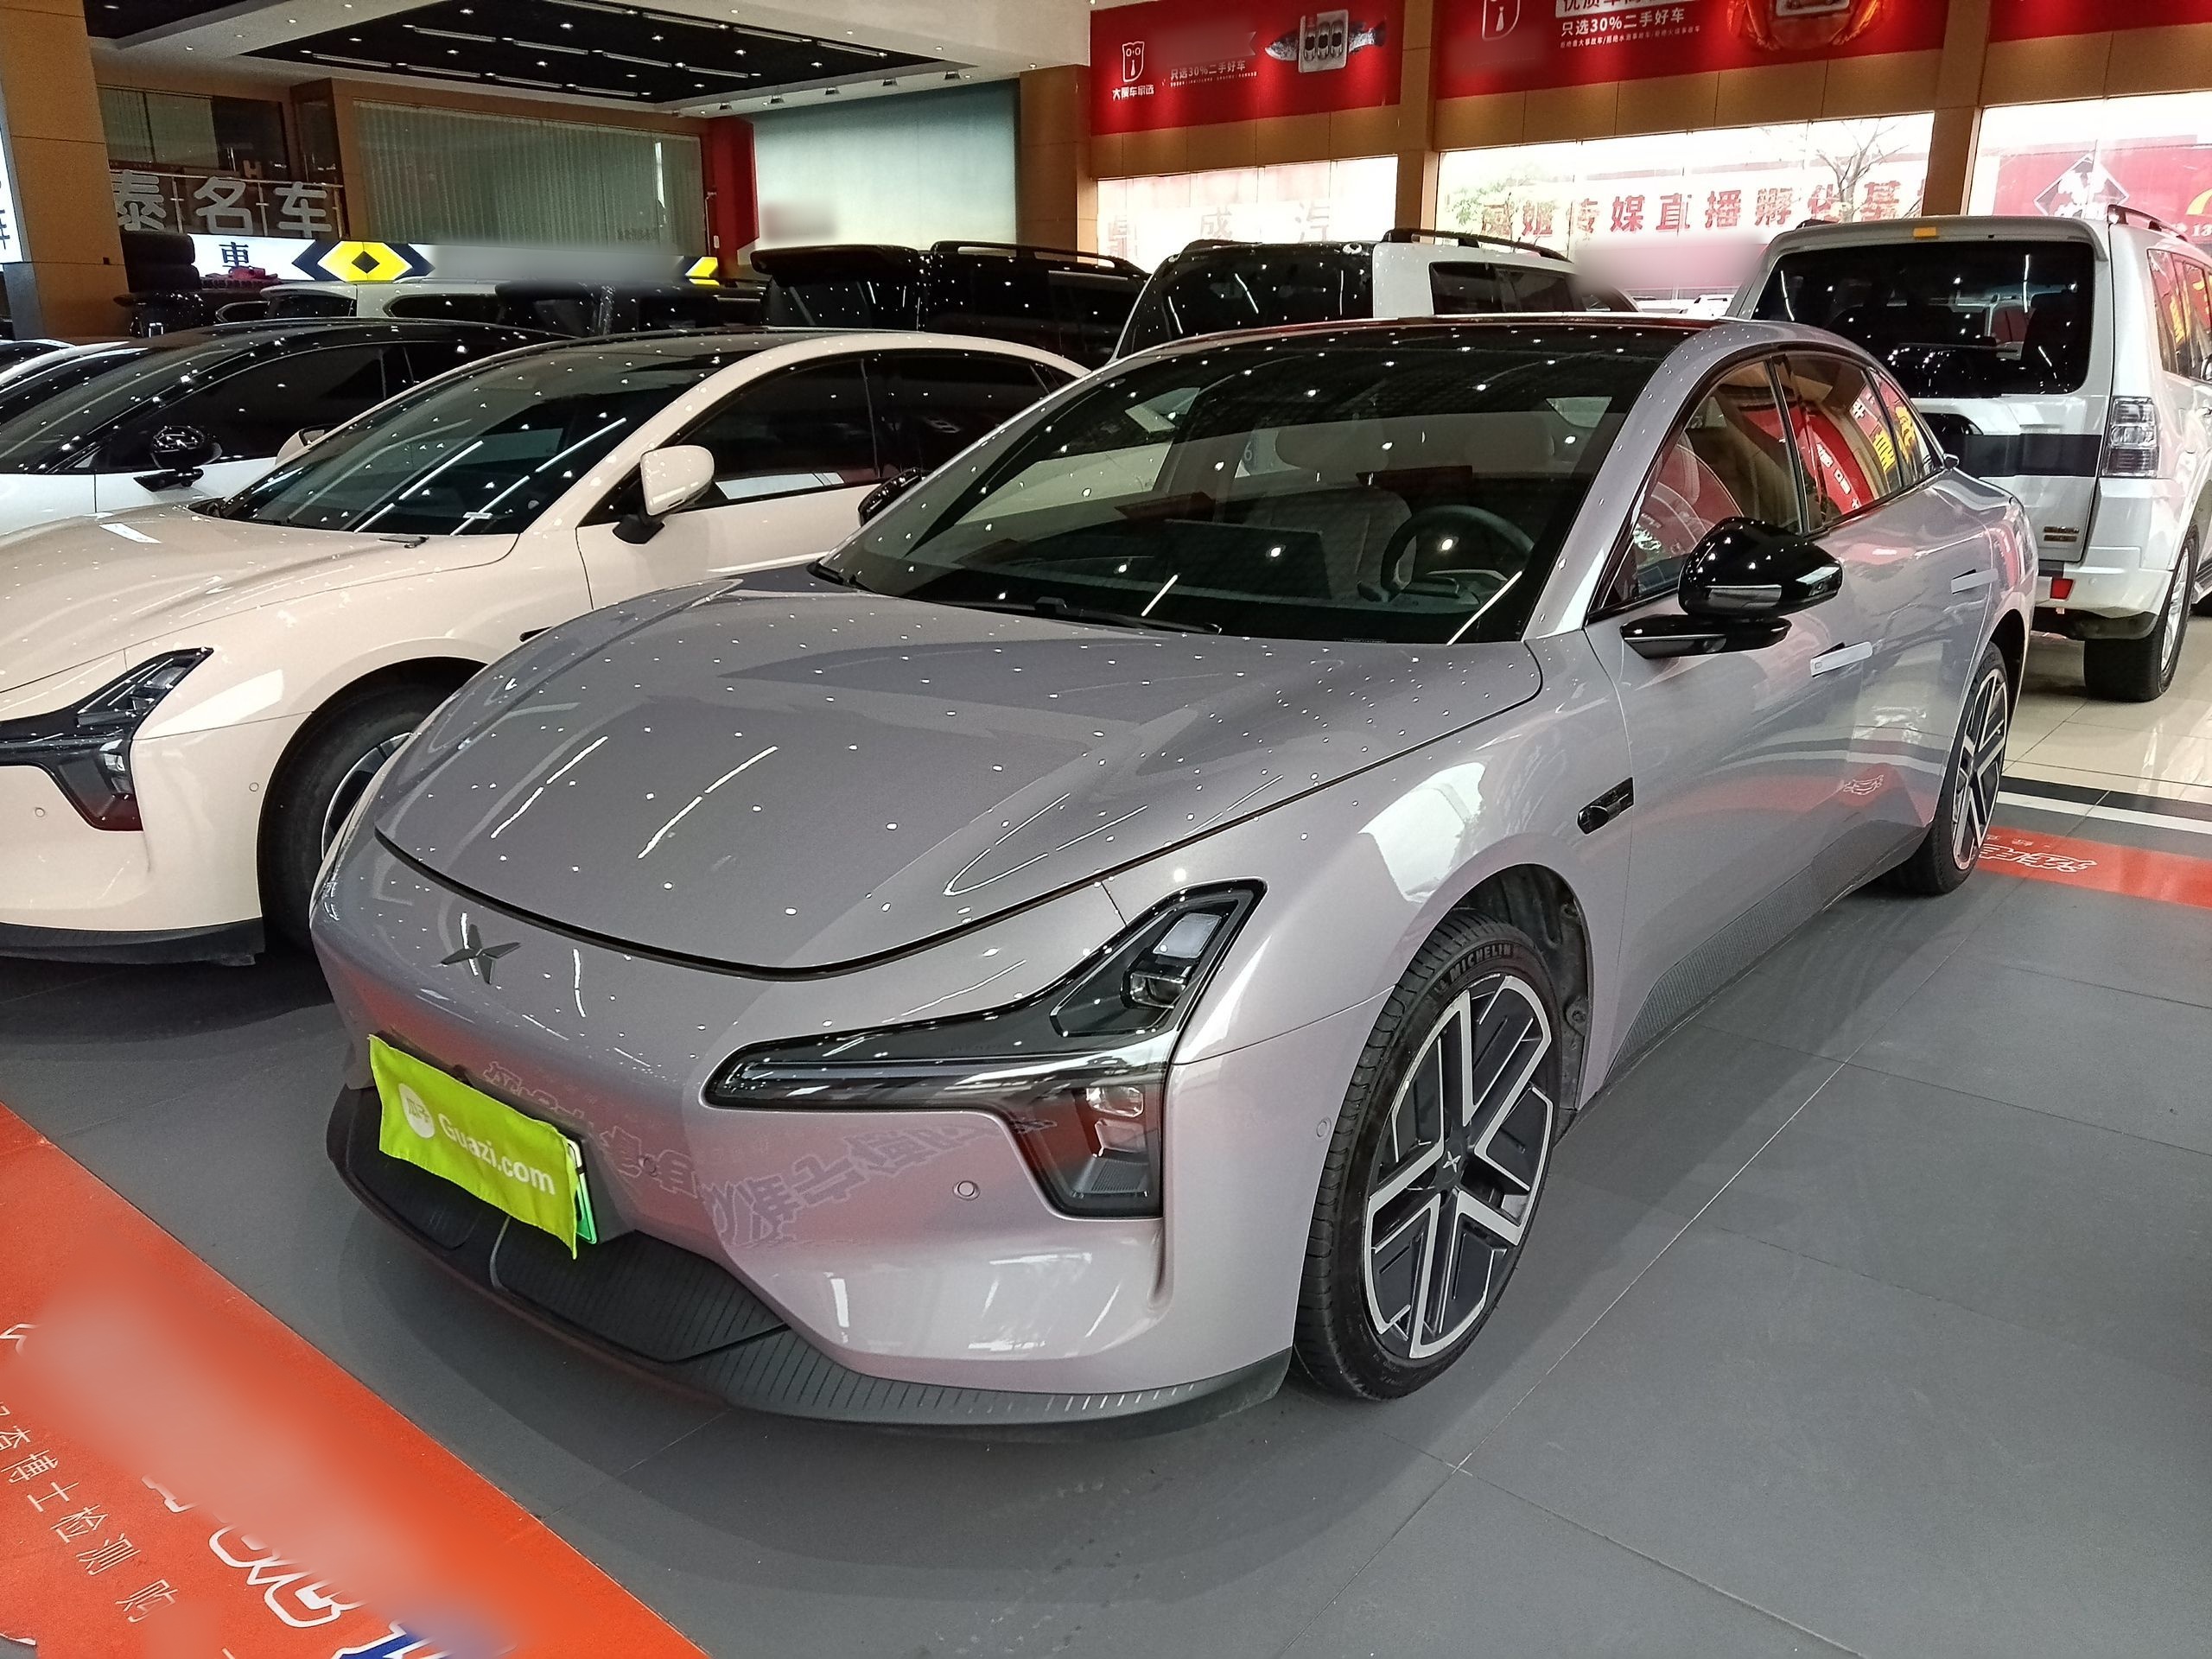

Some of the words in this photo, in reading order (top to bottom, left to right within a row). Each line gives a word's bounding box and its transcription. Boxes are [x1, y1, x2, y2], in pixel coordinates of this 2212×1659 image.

[1560, 7, 1685, 37] 只选30%二手好车
[1170, 59, 1246, 80] 只选30%二手好车
[219, 241, 250, 268] 車
[1450, 944, 1512, 983] MICHELIN
[438, 1112, 556, 1196] Guazi.com
